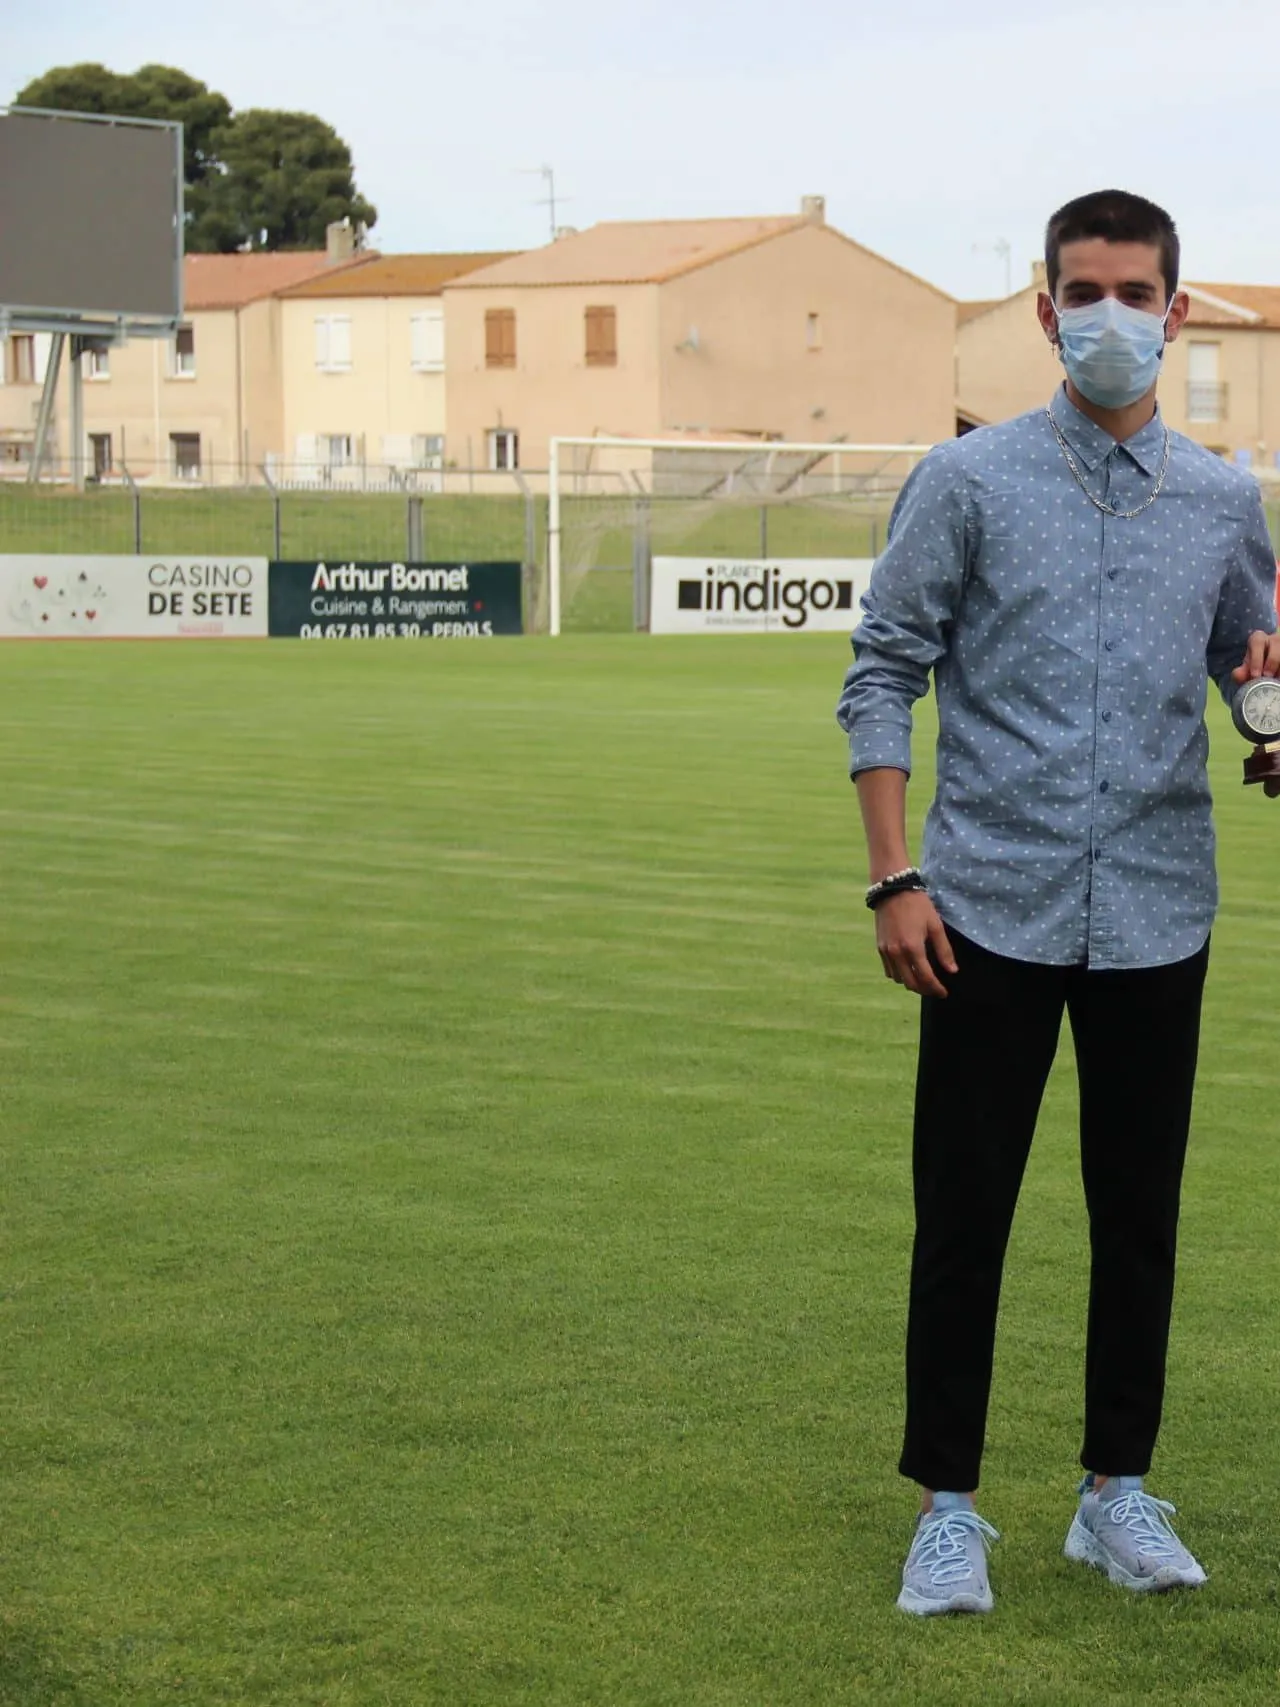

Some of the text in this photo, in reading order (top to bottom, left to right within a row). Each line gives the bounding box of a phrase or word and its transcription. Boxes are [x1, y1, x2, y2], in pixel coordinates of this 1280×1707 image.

[148, 563, 253, 588] CASINO
[311, 562, 469, 592] Arthur Bonnet
[149, 591, 252, 616] DE SETE
[310, 596, 368, 616] Cuisine
[372, 596, 385, 615] &
[706, 567, 834, 628] indigo
